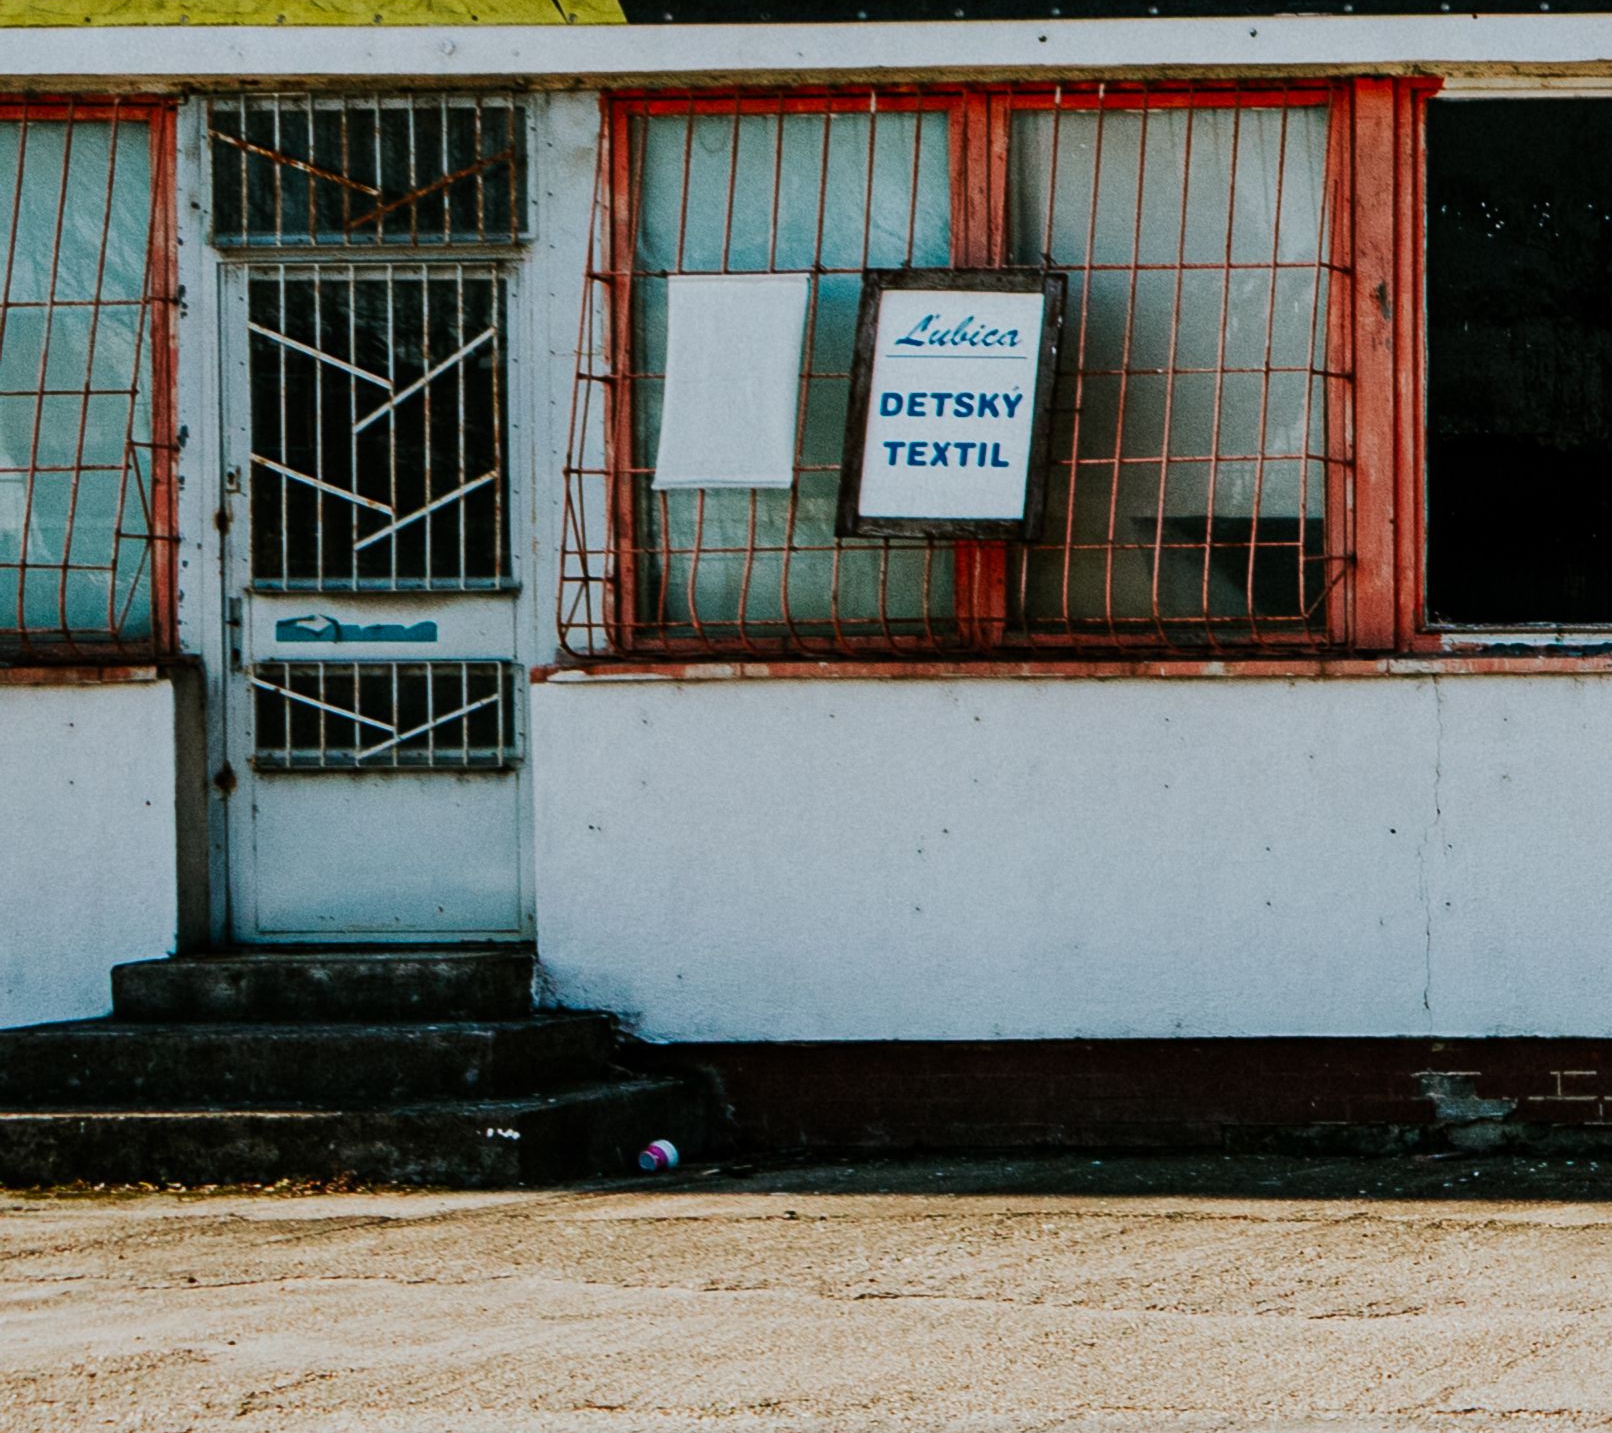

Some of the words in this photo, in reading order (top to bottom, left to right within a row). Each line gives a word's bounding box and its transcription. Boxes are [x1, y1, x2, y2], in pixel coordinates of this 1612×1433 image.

[894, 314, 1023, 347] Ľubica
[879, 385, 1024, 419] DETSKÝ
[882, 440, 1010, 468] TEXTIL
